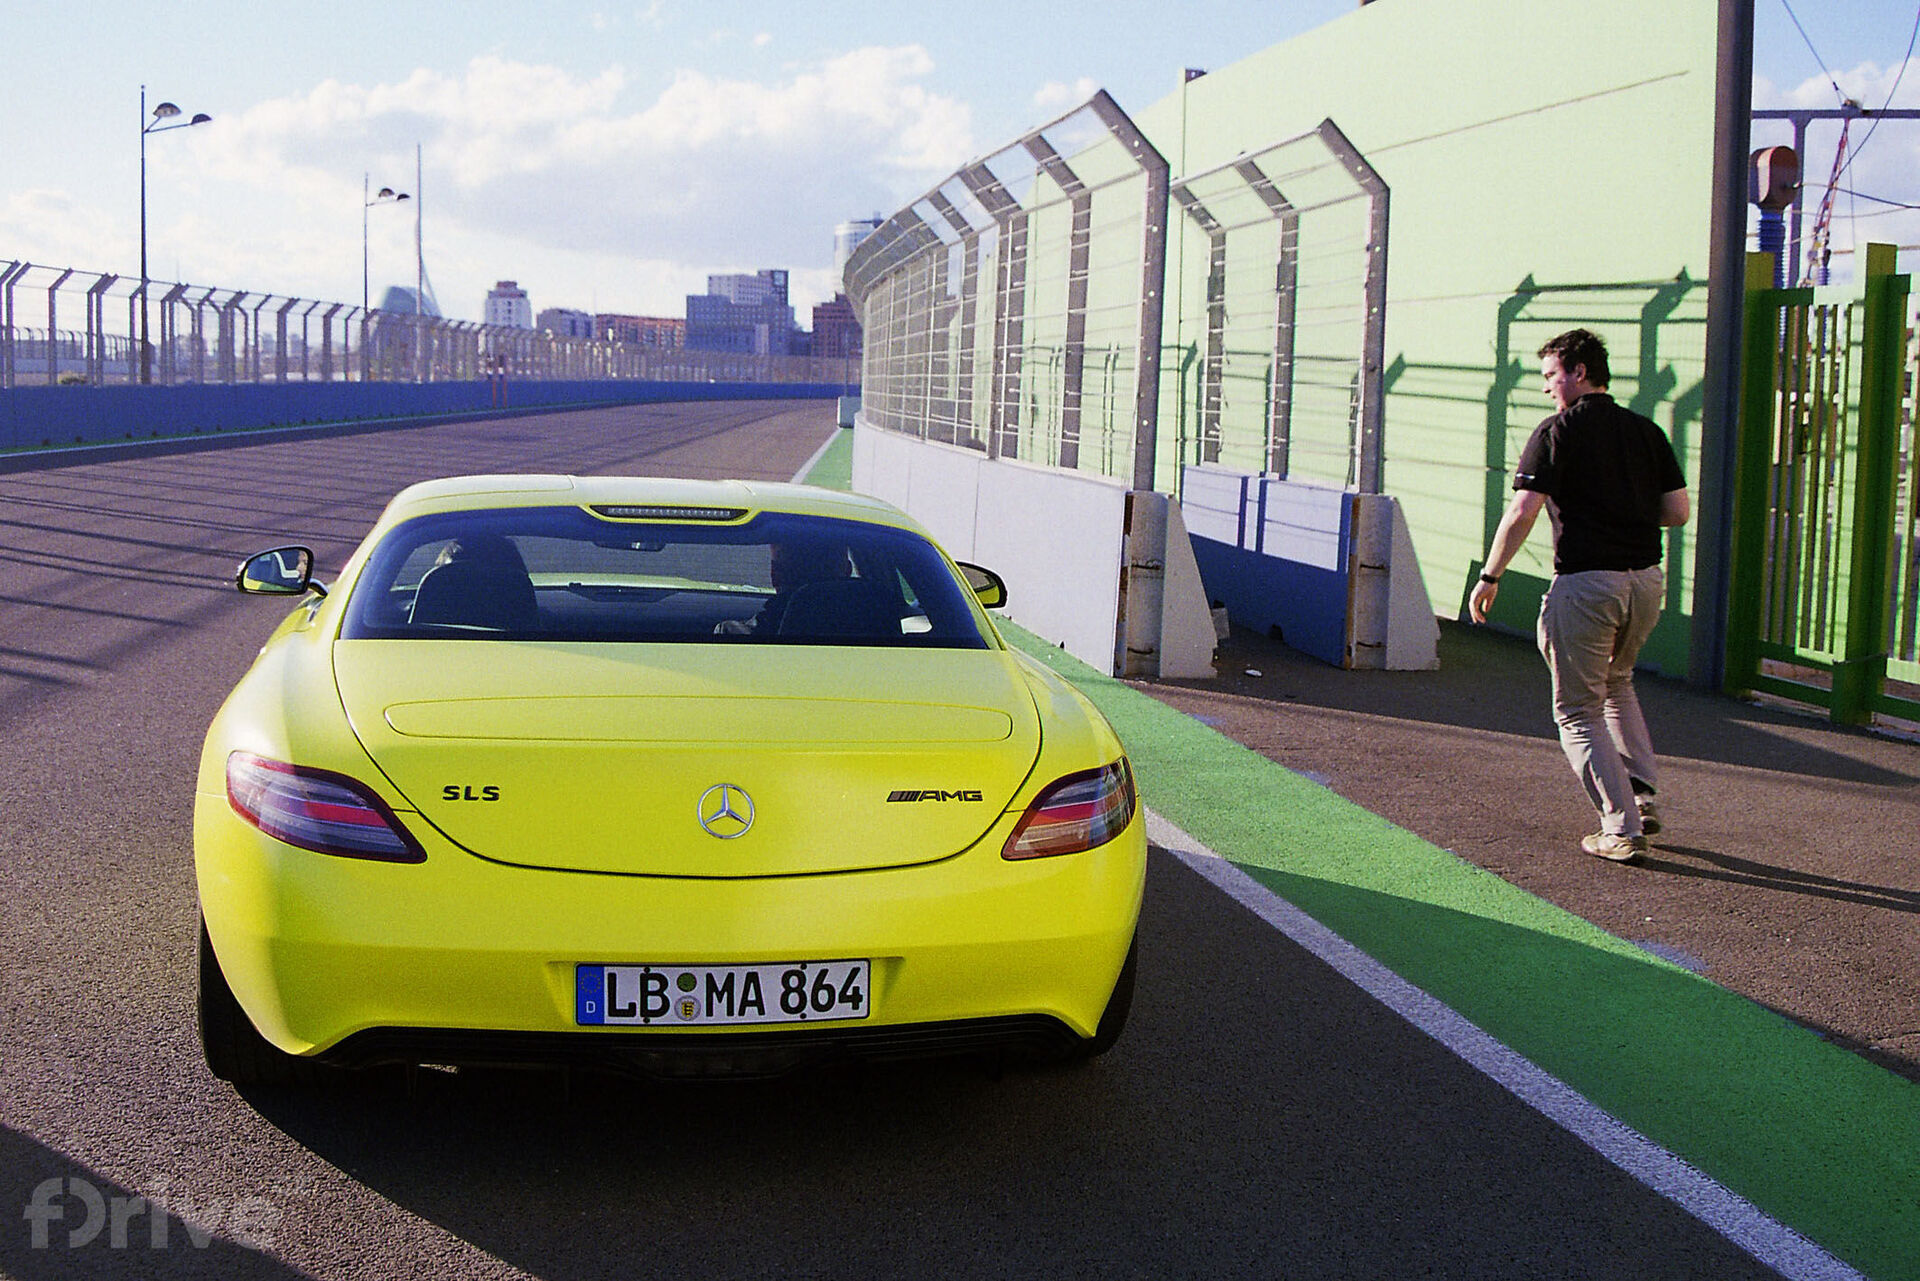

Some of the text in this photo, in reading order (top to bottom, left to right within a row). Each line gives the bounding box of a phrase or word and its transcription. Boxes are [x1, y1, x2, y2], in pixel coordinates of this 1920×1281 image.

[442, 785, 500, 802] SLS
[917, 790, 983, 802] AMG
[607, 967, 864, 1018] LB MA 864
[586, 1000, 596, 1014] D
